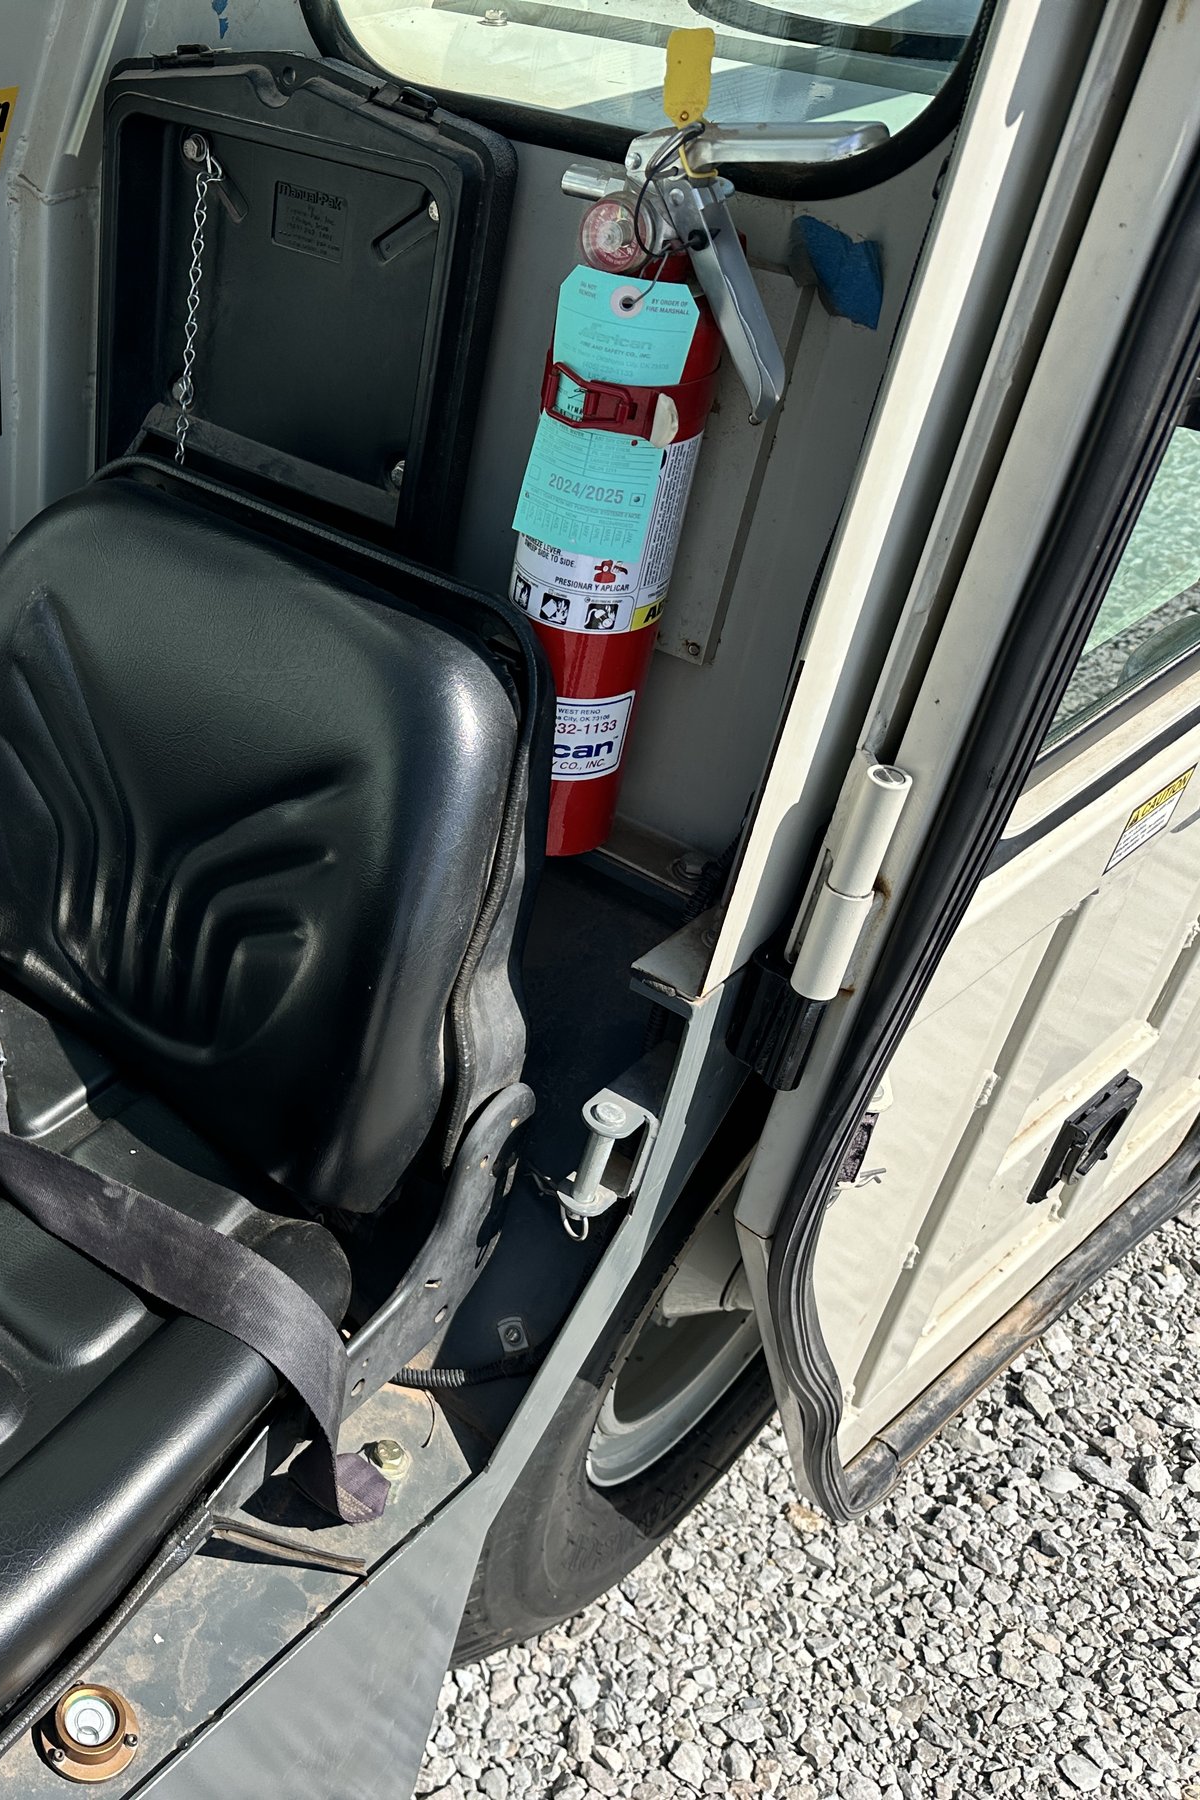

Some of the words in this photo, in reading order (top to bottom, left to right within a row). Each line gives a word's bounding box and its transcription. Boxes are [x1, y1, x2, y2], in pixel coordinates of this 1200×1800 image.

[548, 473, 624, 504] 2024/2025
[550, 555, 558, 563] TO
[559, 557, 576, 568] SIDE.
[554, 576, 592, 590] PRESIONAR
[594, 583, 599, 591] Y
[600, 584, 630, 592] APLICAR
[556, 719, 617, 735] 32-1133
